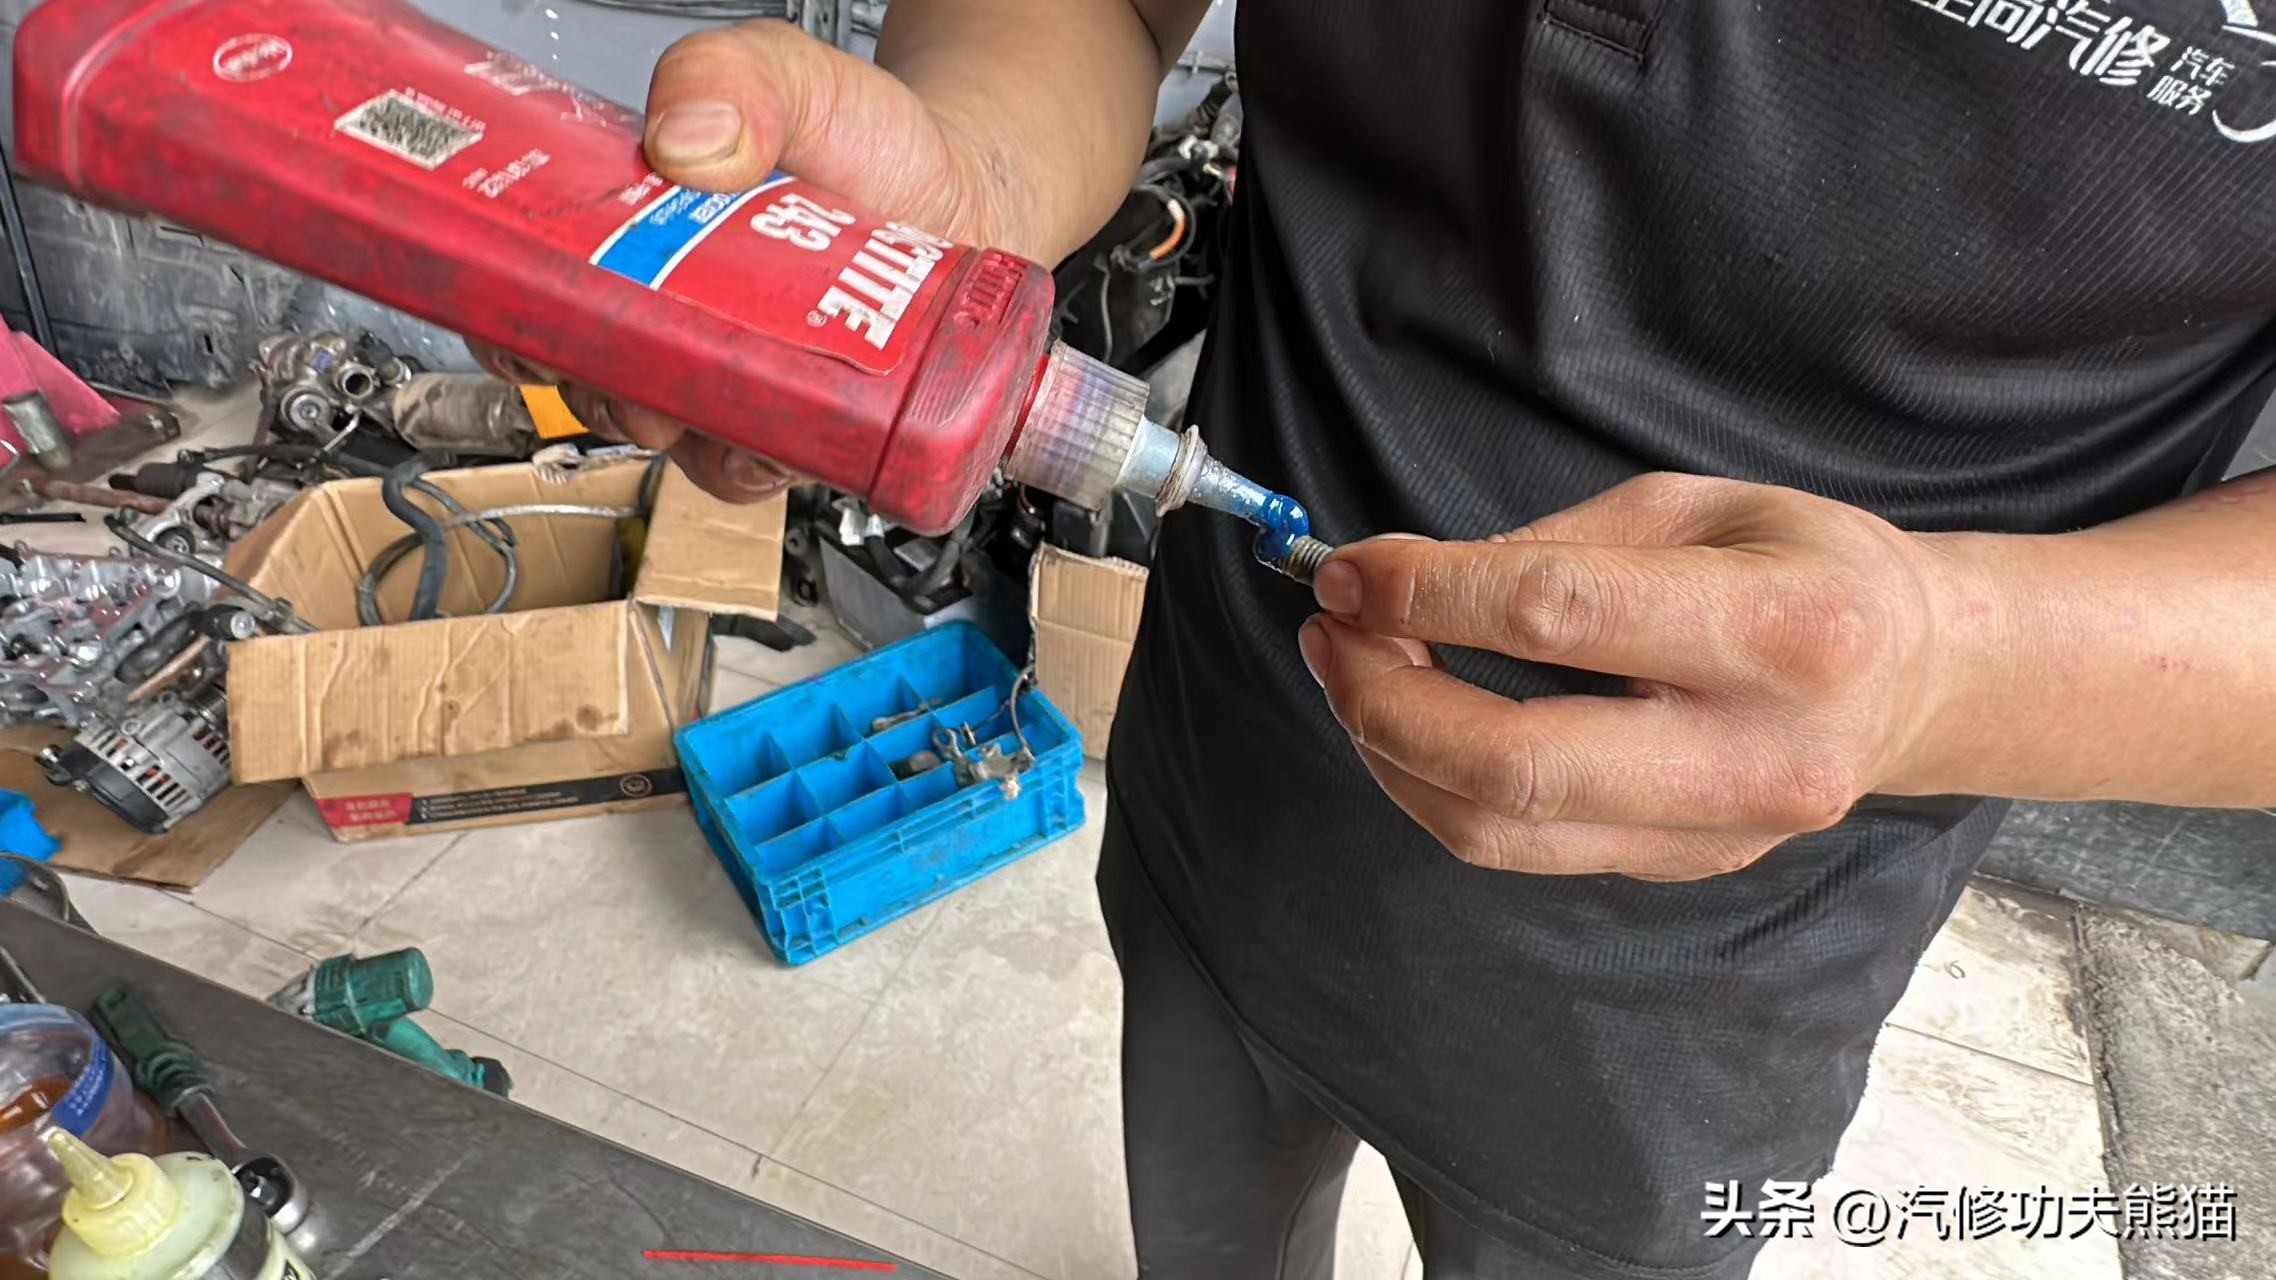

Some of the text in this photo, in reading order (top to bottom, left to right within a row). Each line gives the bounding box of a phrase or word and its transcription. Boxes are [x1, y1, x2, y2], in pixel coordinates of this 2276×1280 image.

[2170, 46, 2236, 86] 汽车
[2146, 75, 2213, 116] 服务
[750, 192, 856, 252] 243
[816, 220, 956, 351] OCTITE
